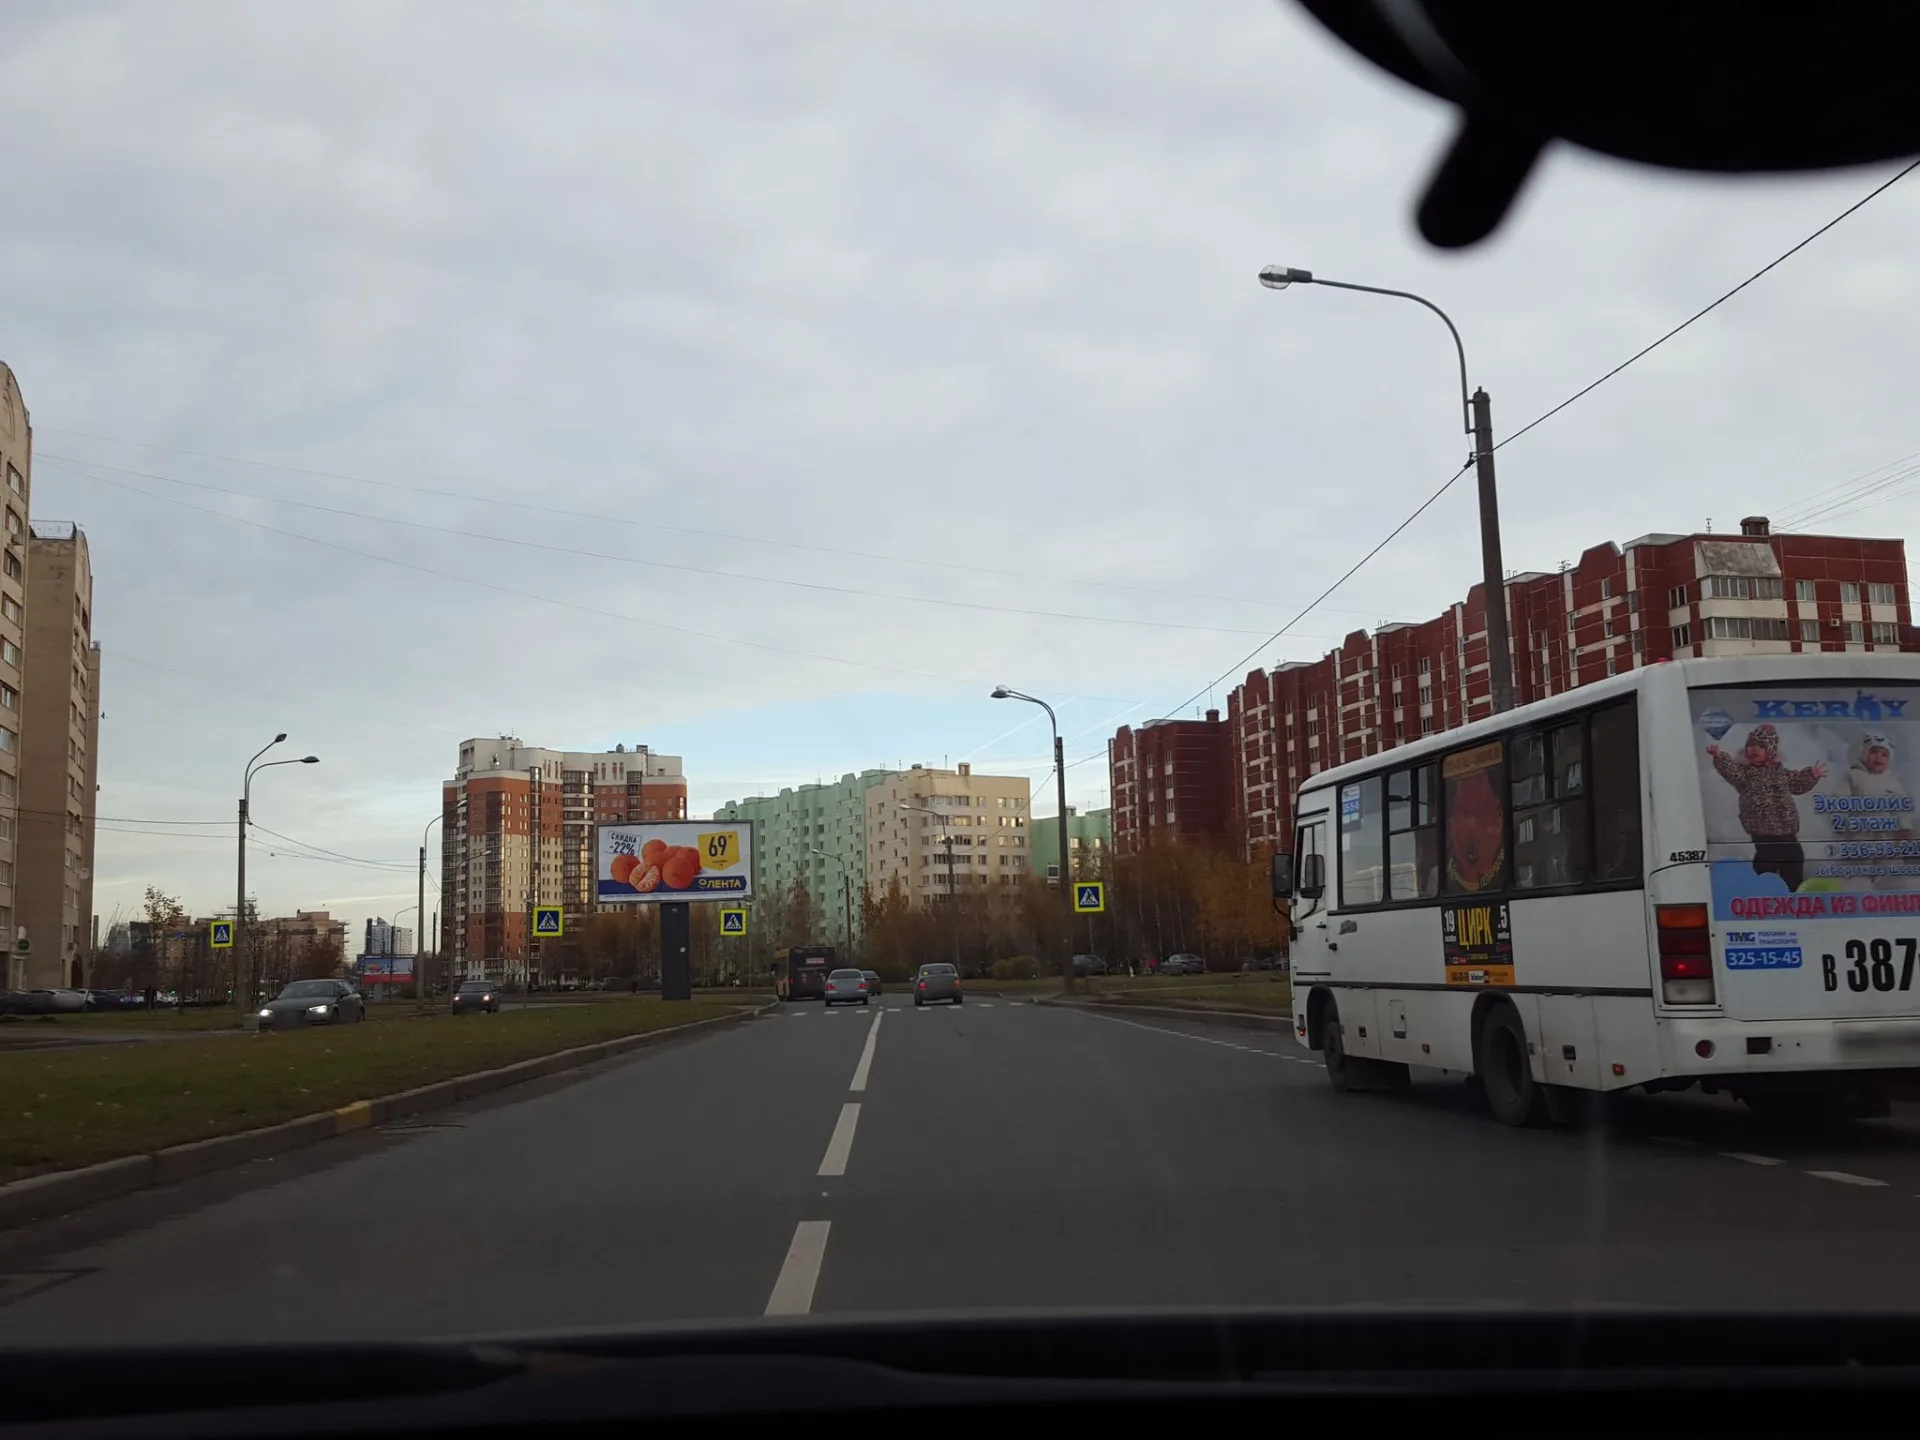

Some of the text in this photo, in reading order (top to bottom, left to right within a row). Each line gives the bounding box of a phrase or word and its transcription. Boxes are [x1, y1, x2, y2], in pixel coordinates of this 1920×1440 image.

[1814, 793, 1912, 811] Экополис
[1832, 814, 1899, 831] 2 этаж
[611, 832, 636, 843] СКИДКА
[709, 835, 726, 856] 69
[609, 841, 635, 855] -22%
[1669, 850, 1706, 862] 45387
[706, 879, 742, 889] ЛЕНТА
[1730, 897, 1827, 919] ОДЕЖДА
[1831, 896, 1857, 914] ИЗ
[1444, 910, 1455, 932] 19
[1457, 907, 1493, 951] ЦИРК
[1727, 932, 1755, 942] TMG
[1727, 950, 1801, 966] 325-15-45
